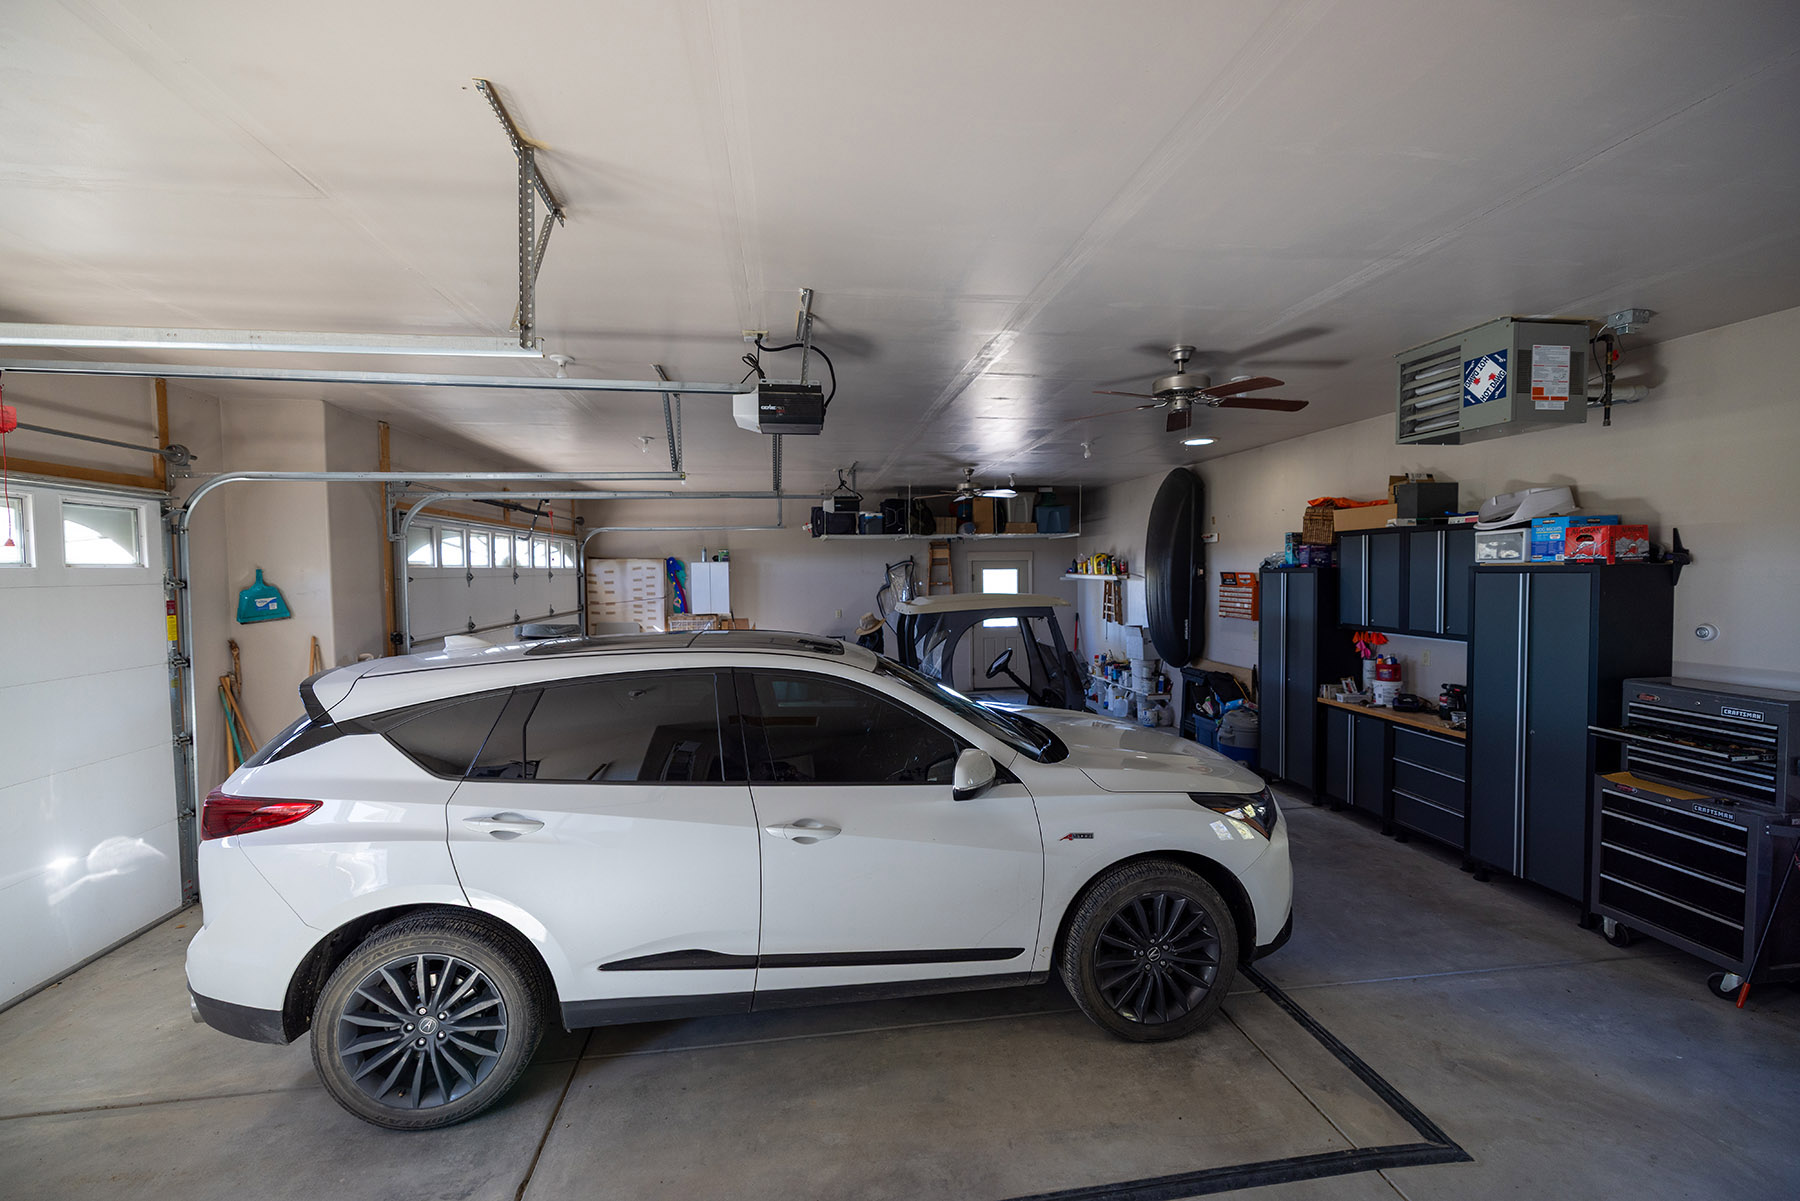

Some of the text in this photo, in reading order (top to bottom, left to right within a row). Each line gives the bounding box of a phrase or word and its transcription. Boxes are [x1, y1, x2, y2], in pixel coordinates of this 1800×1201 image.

[1464, 356, 1490, 388] HOT DAWG
[1480, 370, 1506, 402] HOT DAWG
[1723, 708, 1761, 720] CRAFTSMAN
[1694, 805, 1734, 820] CRAFTSMAN
